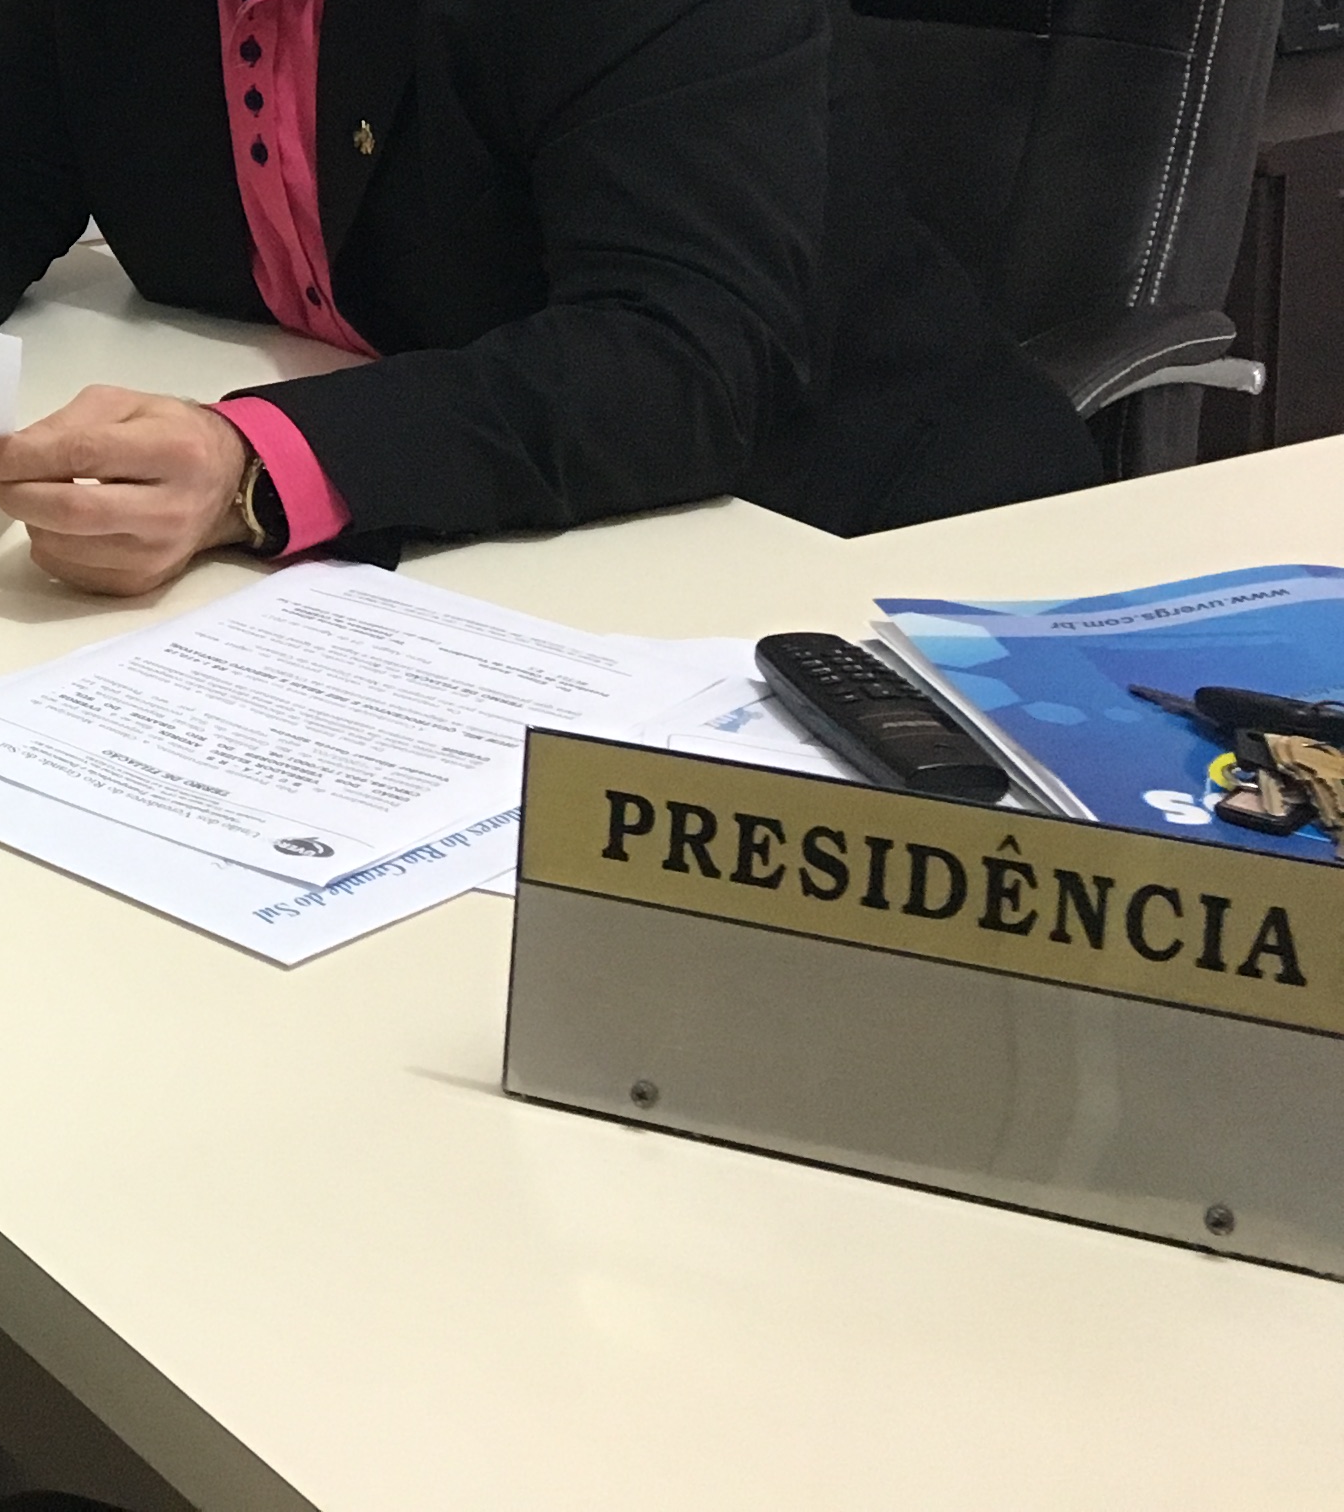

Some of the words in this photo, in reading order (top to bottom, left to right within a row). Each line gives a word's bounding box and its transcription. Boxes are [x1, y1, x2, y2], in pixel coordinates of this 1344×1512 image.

[1050, 588, 1291, 631] www.uvergs.com.br
[439, 829, 472, 847] do
[404, 845, 447, 864] Rio
[296, 890, 326, 906] do
[601, 789, 1308, 988] PRESIDÊNCIA
[252, 902, 300, 924] Sul
